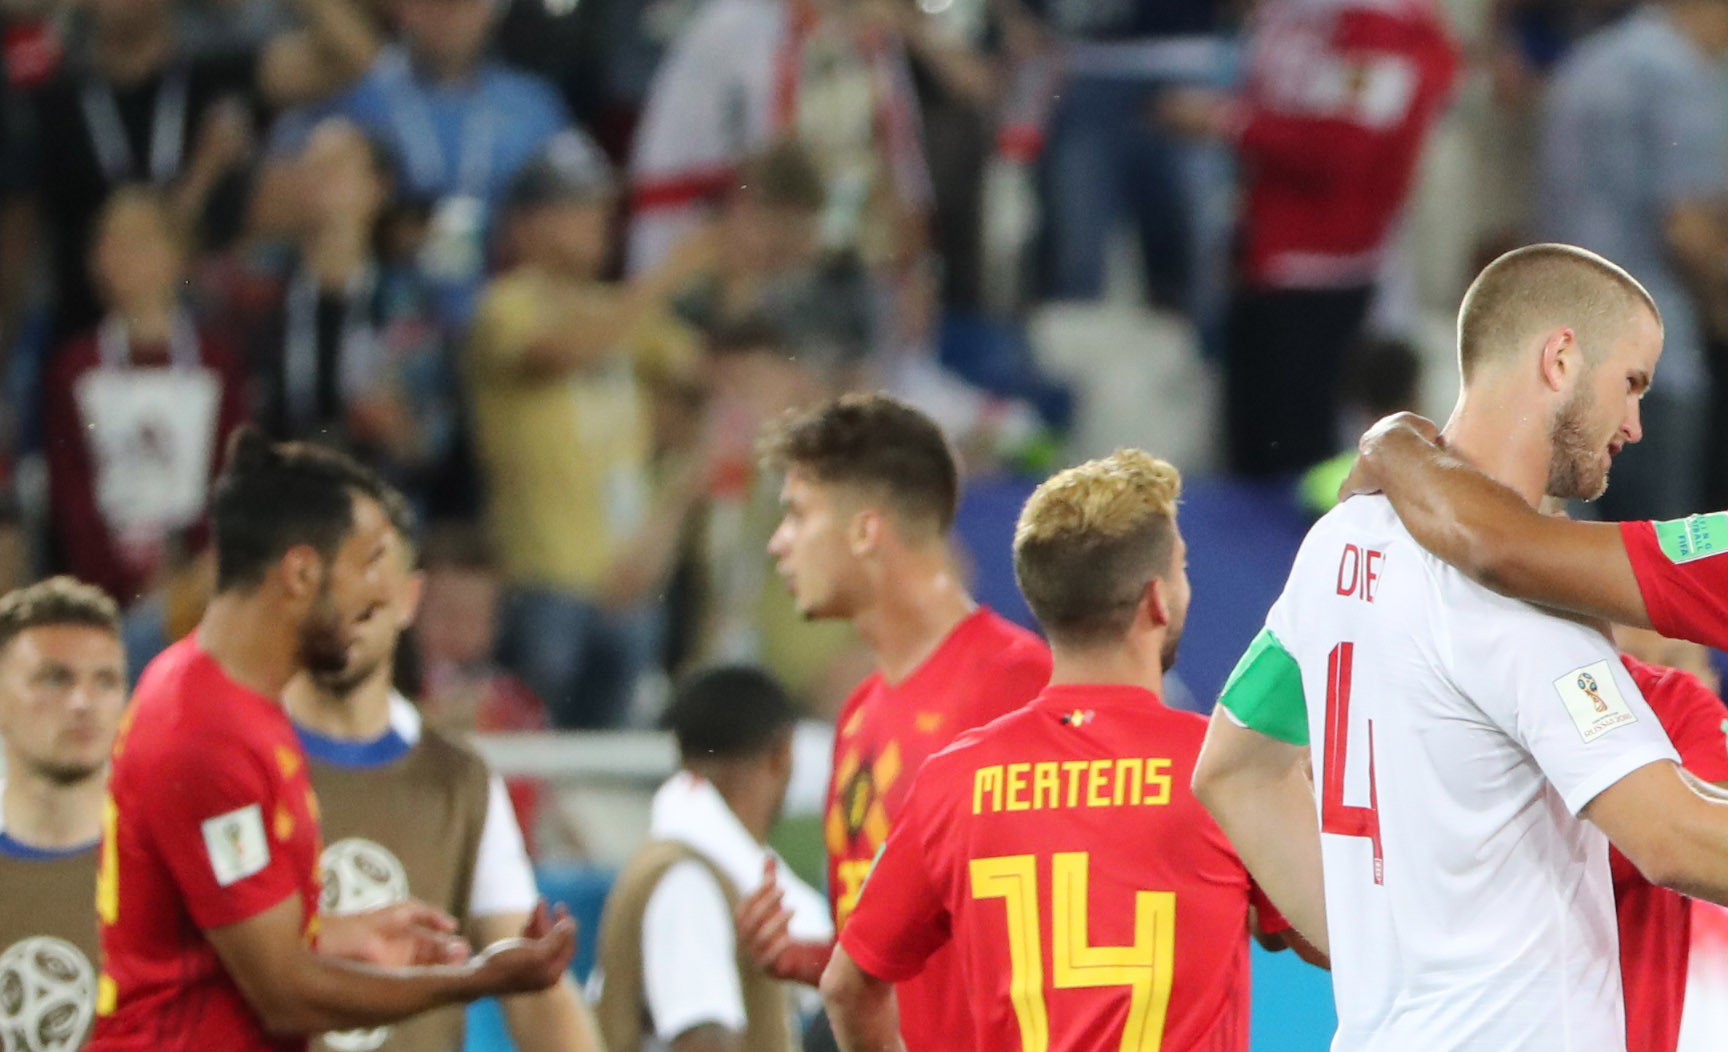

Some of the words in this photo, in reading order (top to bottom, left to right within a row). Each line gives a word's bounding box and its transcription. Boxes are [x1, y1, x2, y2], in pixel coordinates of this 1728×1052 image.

[1336, 543, 1386, 603] DIE
[972, 757, 1172, 814] MERTENS
[1321, 641, 1384, 886] 4
